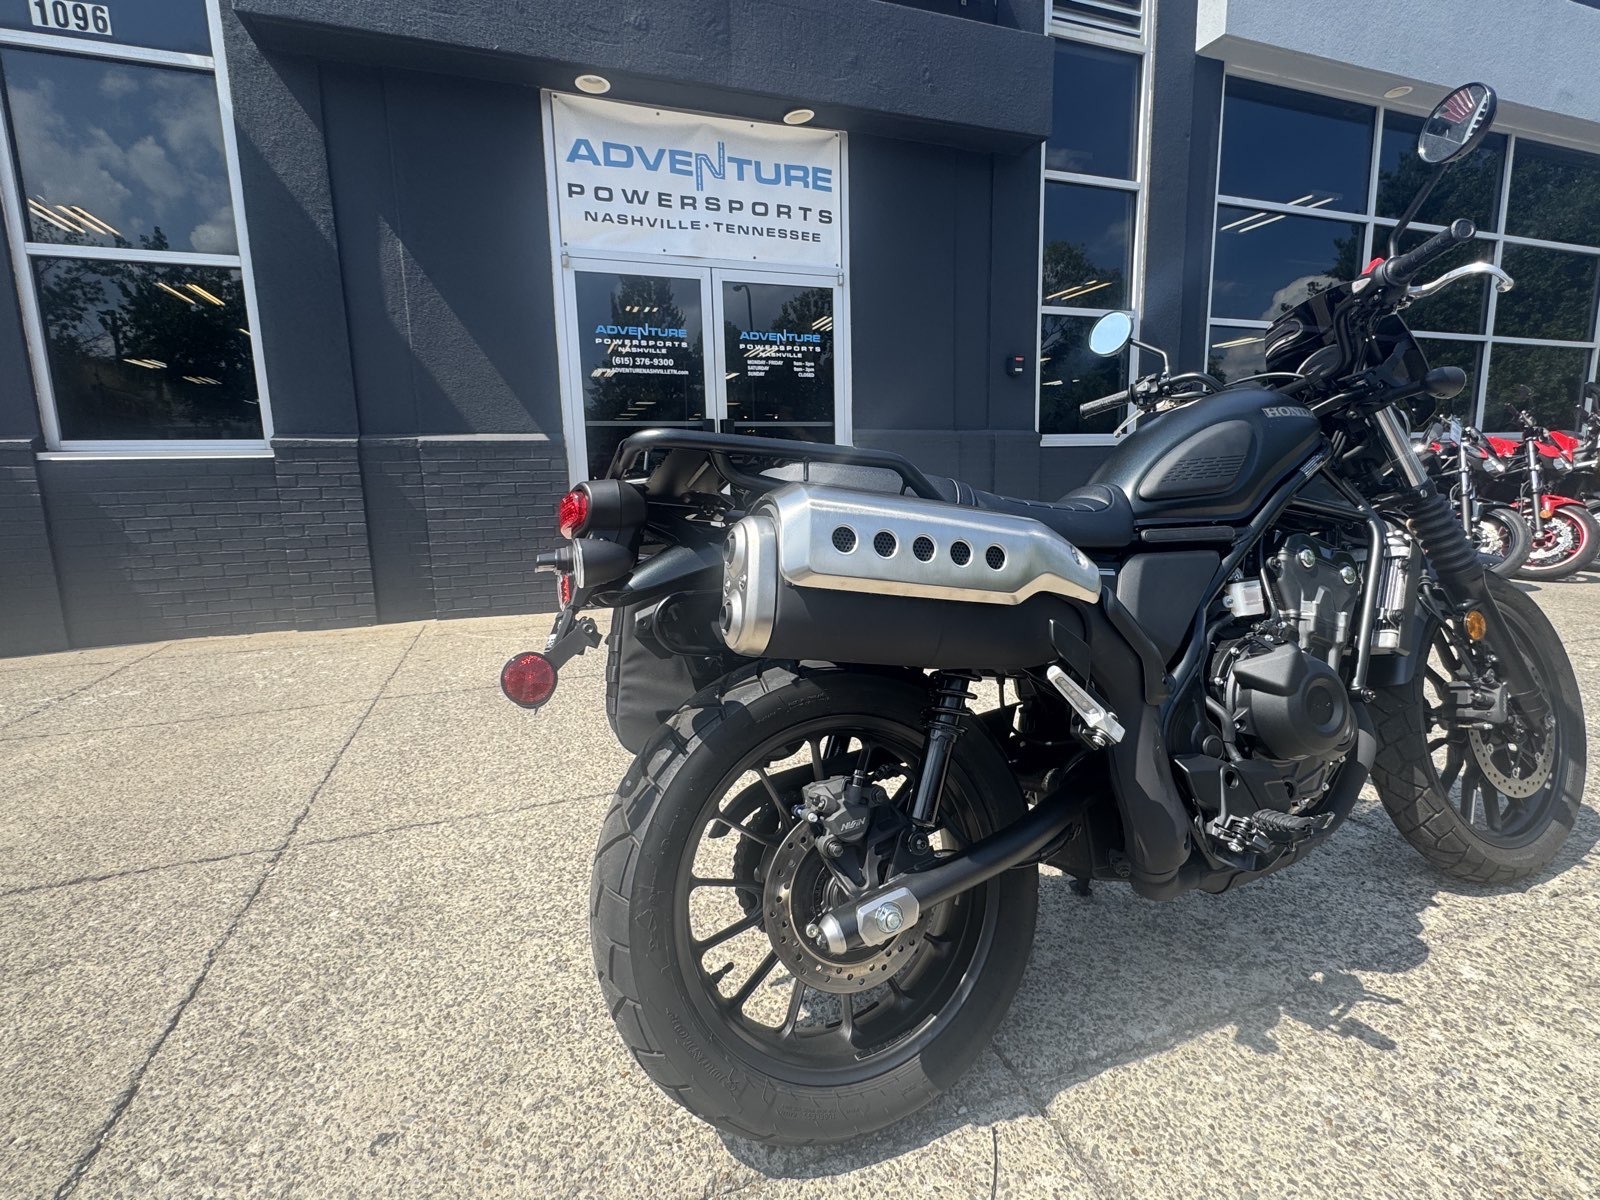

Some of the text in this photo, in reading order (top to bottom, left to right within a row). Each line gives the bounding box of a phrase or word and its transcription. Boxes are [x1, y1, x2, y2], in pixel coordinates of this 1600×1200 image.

[34, 0, 108, 33] 1096
[566, 138, 832, 192] ADVENTURE
[567, 182, 833, 224] POWERSPORTS
[595, 323, 688, 339] ADVENTURE
[739, 329, 821, 345] ADVENTURE
[595, 338, 688, 347] POWERSPORTS
[739, 344, 821, 352] POWERSPORTS
[612, 356, 674, 366] (615) 376-9300
